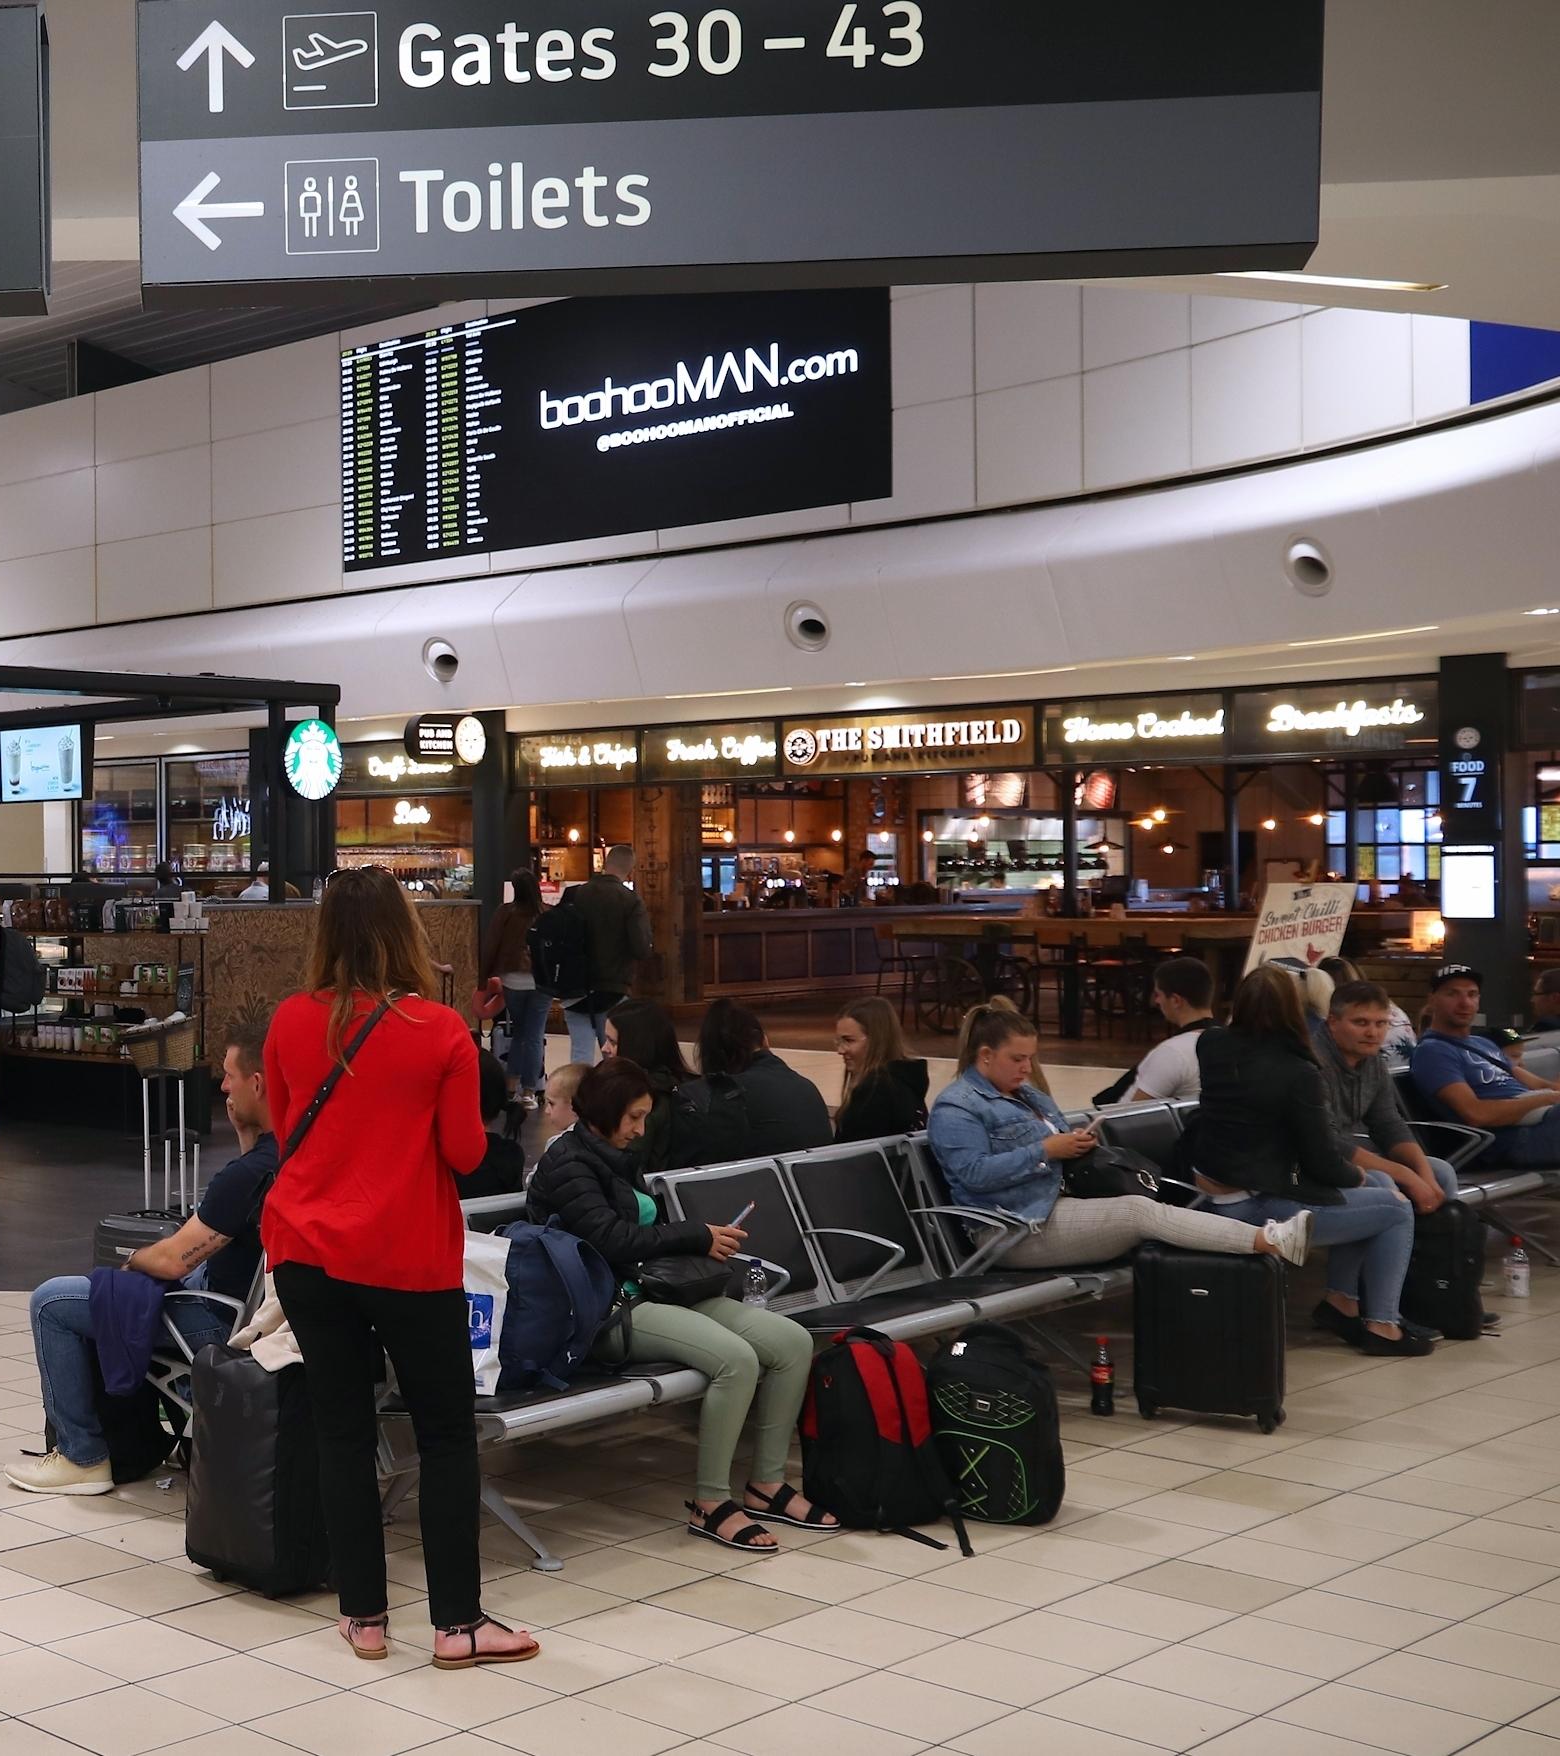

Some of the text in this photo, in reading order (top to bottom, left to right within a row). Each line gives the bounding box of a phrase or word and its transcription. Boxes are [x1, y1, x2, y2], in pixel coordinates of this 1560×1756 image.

[397, 19, 617, 91] Gates
[647, 8, 743, 79] 30
[825, 0, 927, 69] 43
[399, 163, 652, 235] Toilets
[540, 342, 859, 430] boohooMAN.com
[596, 402, 794, 453] @BOOHOOMANOFFICIAL
[1063, 709, 1225, 743] Home Cooked
[1266, 698, 1424, 737] Breakfasts
[419, 729, 453, 739] PUB AND
[420, 740, 453, 749] KITCHEN
[816, 728, 862, 753] THE
[867, 718, 1023, 750] SMITHFIELD
[539, 742, 637, 770] Fish & Chips
[666, 738, 718, 761] Fresh
[721, 735, 776, 765] Coffee
[1451, 761, 1485, 773] FOOD
[1458, 777, 1478, 802] 7
[1262, 900, 1341, 928] Sweet Chilli
[1258, 916, 1344, 946] CHICKEN BURGER
